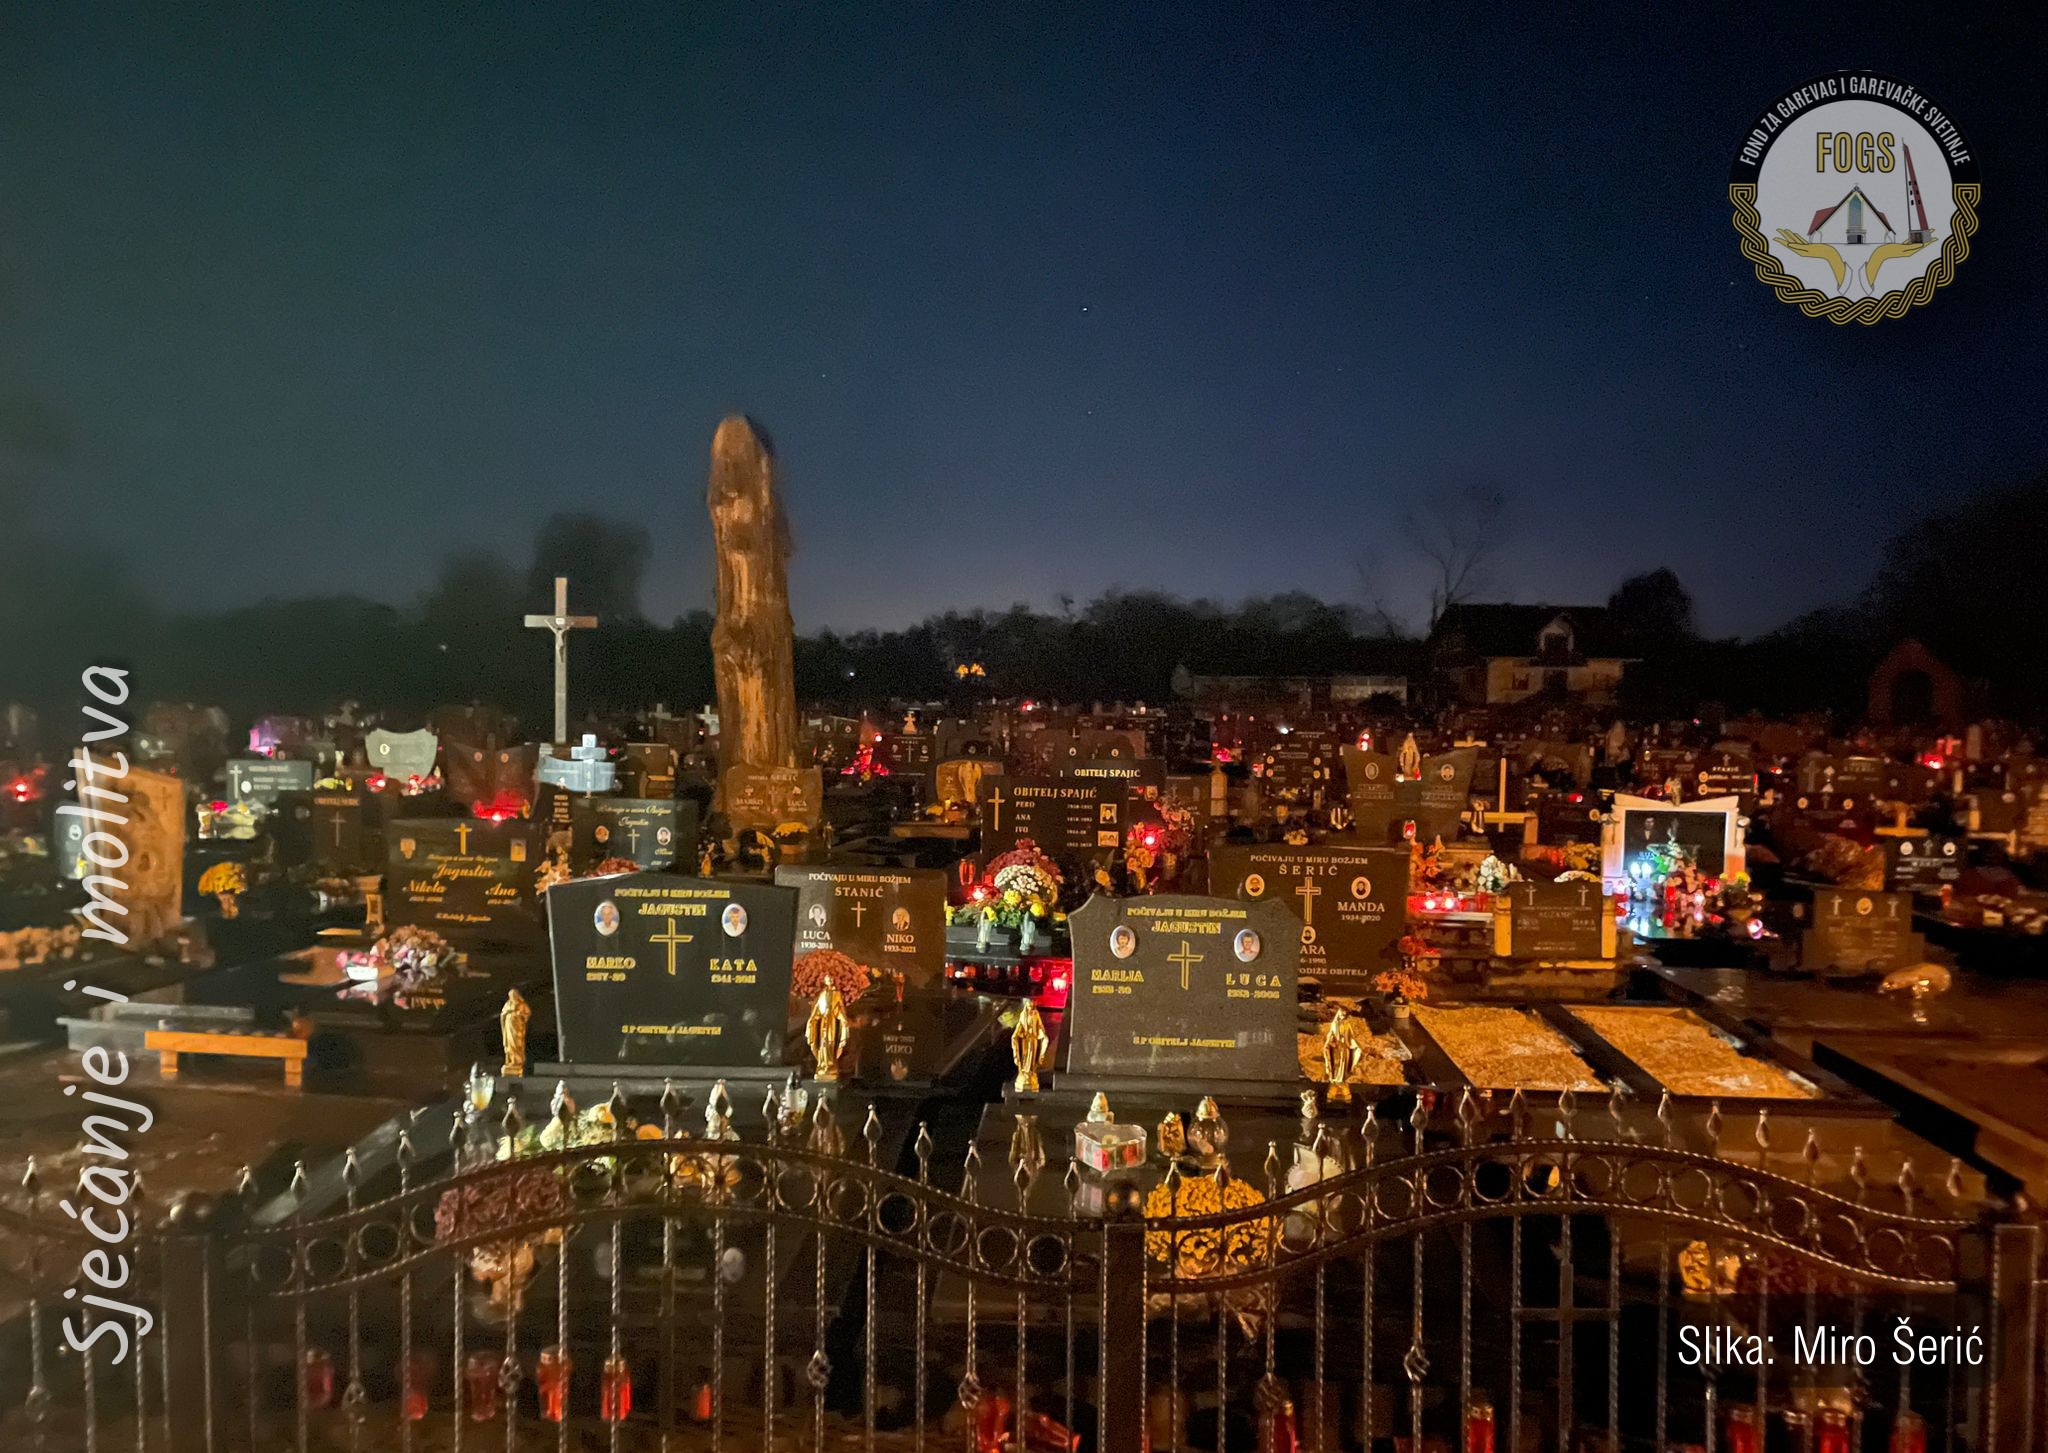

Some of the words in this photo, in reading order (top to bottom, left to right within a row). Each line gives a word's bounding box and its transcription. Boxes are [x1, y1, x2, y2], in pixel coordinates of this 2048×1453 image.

[1075, 768, 1108, 778] OBITELJ
[1110, 768, 1141, 778] SPAJIĆ
[1013, 787, 1058, 799] OBITELJ
[1060, 786, 1098, 799] SPAJIĆ
[1015, 801, 1036, 809] PERO
[1015, 826, 1029, 834] IVO
[1305, 856, 1328, 864] MIRU
[1331, 856, 1368, 865] BOŽJEM
[432, 863, 495, 881] Jagustin
[1279, 865, 1338, 876] ŠERIĆ
[856, 875, 878, 883] MIRU
[879, 874, 911, 884] BOŽJEM
[402, 880, 447, 893] Nikola
[485, 883, 518, 896] Ana
[834, 886, 885, 898] STANIĆ
[638, 903, 707, 916] JAGUSTIN
[1337, 901, 1386, 913] MANDA
[1151, 920, 1222, 934] JAGUSTIN
[803, 930, 831, 940] LUCA
[886, 934, 914, 944] NIKO
[1300, 945, 1326, 955] ARA
[586, 957, 636, 969] MARKO
[709, 958, 758, 971] KATA
[1090, 969, 1145, 982] MARIJA
[1299, 966, 1328, 975] ODIŽE
[1330, 968, 1368, 976] OBITELJ
[1225, 973, 1282, 987] LUCA
